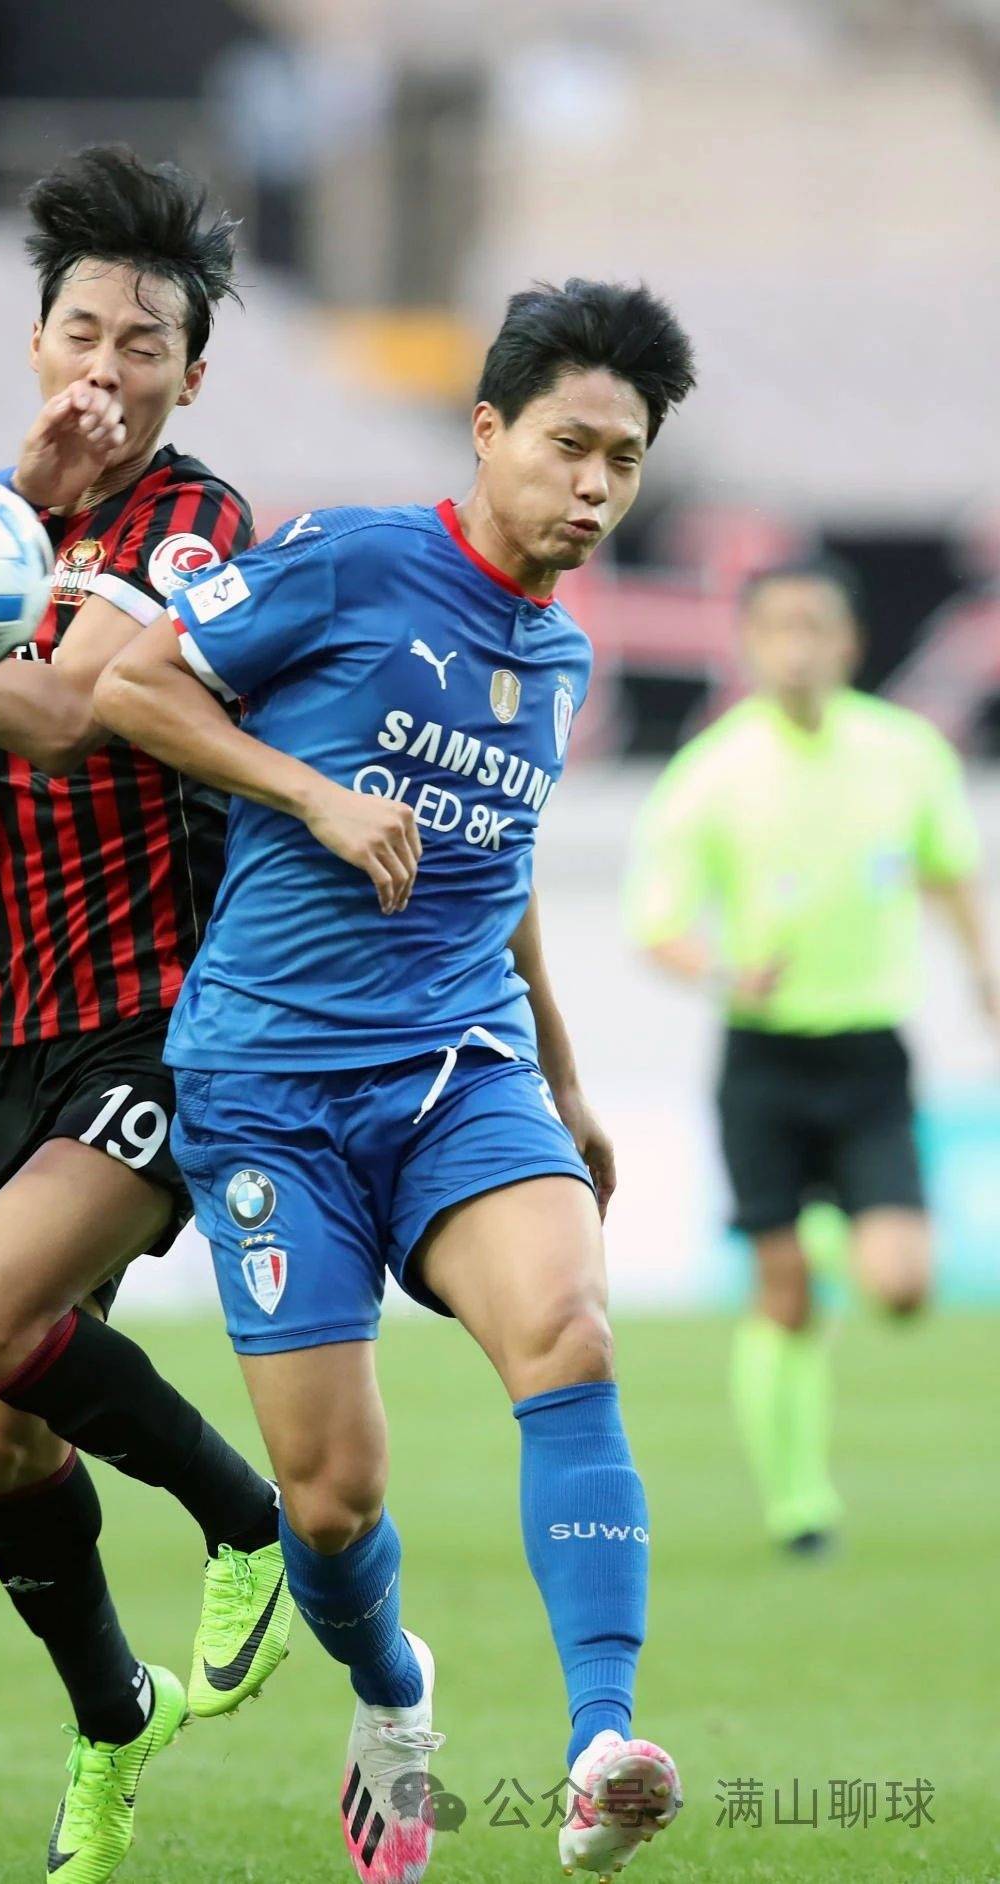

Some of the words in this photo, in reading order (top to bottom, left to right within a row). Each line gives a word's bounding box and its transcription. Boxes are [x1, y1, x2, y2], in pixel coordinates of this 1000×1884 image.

[377, 710, 556, 812] SAMSUN
[464, 804, 515, 851] 8K
[79, 1084, 168, 1169] 19
[228, 1171, 268, 1195] BMW
[549, 1521, 649, 1545] SUWO
